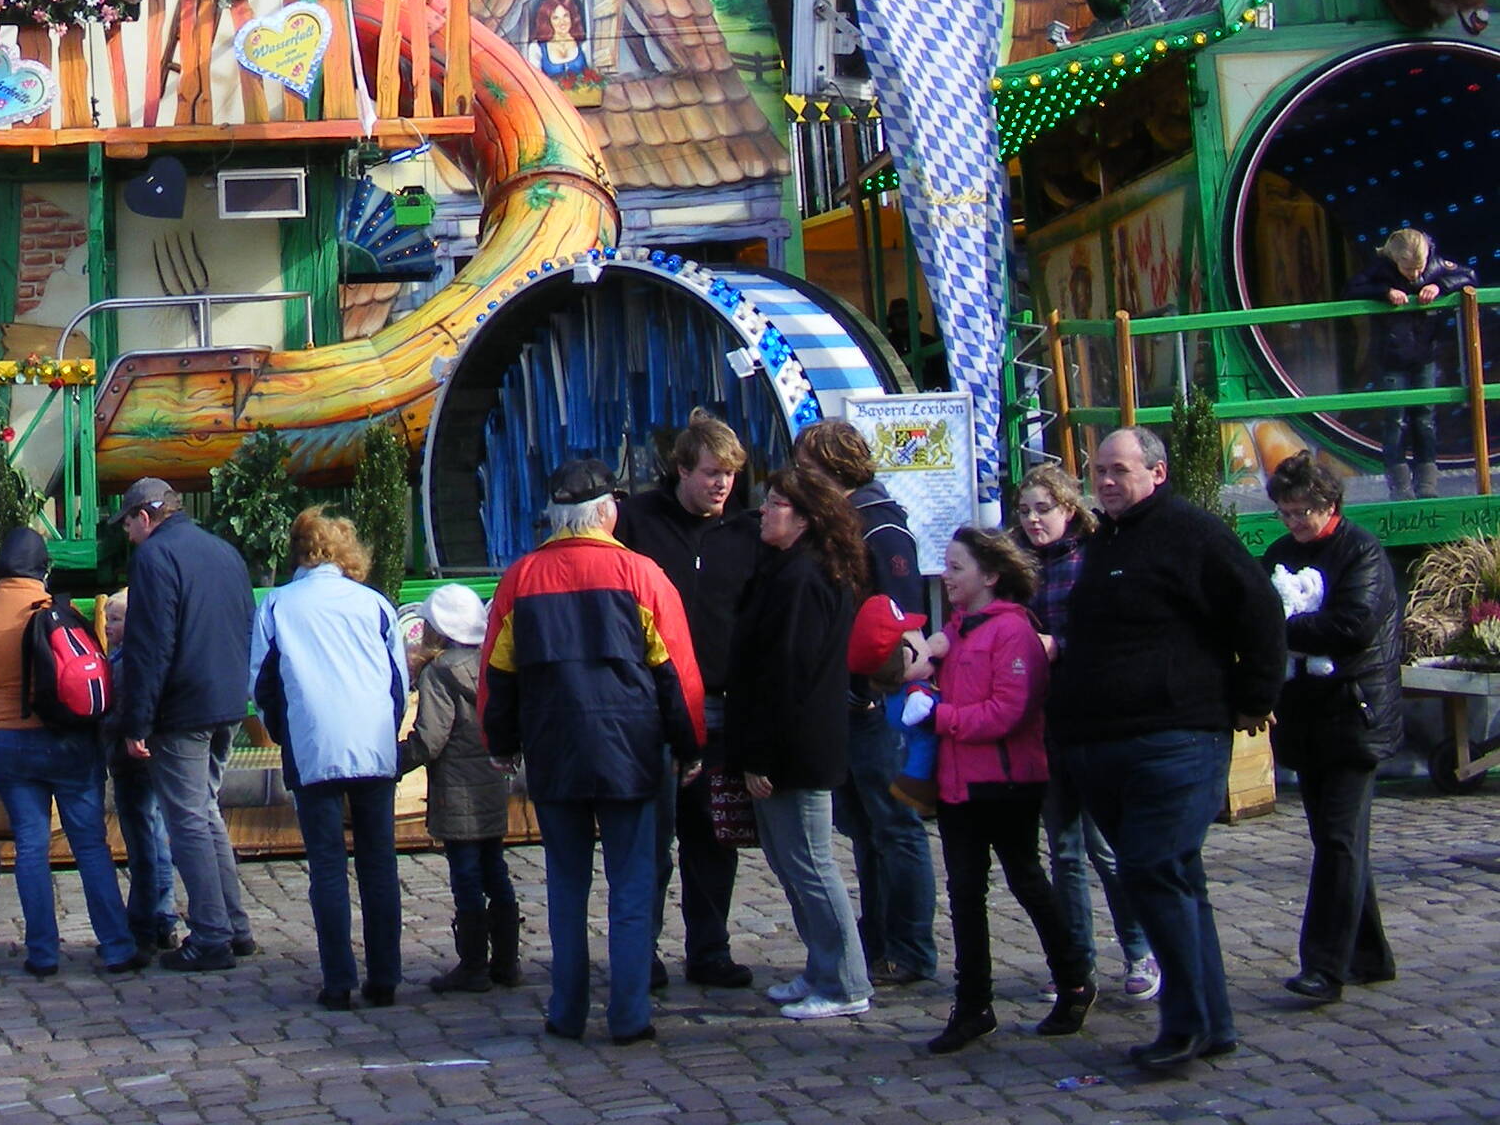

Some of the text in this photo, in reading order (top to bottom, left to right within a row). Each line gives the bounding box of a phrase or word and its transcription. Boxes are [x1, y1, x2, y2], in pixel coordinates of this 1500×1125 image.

[252, 24, 314, 59] Wasserfall
[855, 399, 965, 420] Bayern Lexikon
